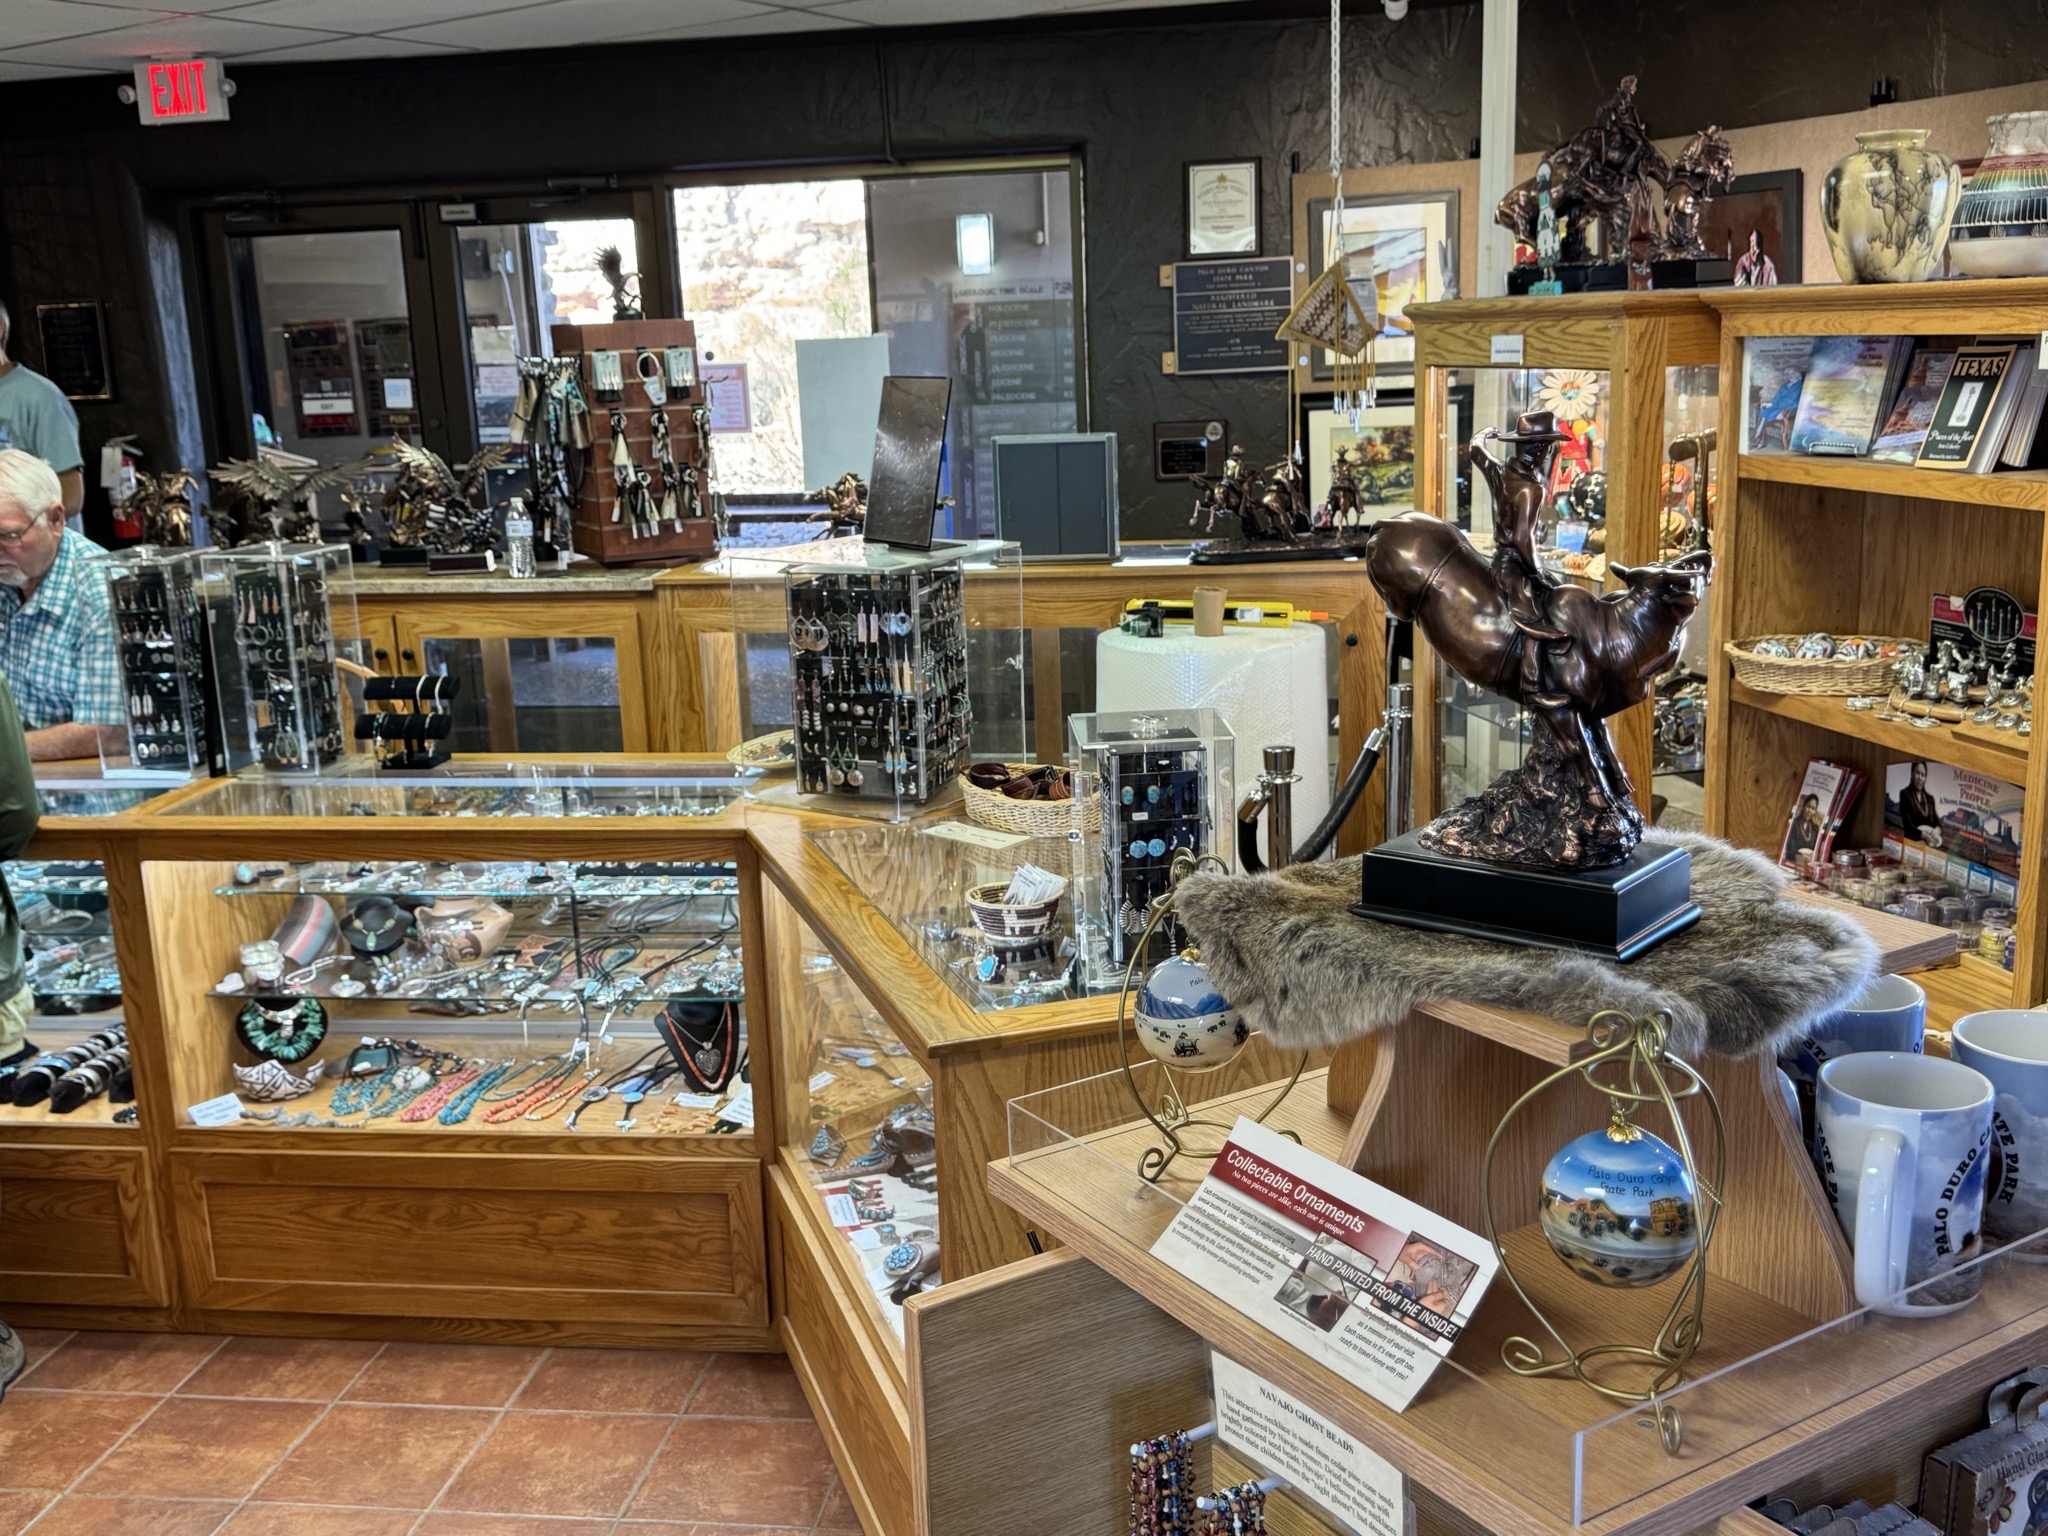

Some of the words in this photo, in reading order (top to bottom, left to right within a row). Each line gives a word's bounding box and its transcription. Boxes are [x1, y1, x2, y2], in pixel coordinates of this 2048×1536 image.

[148, 61, 208, 117] EXIT
[1955, 356, 2006, 376] TEXAS
[1227, 1149, 1292, 1192] Collectable
[1294, 1185, 1364, 1232] Ornaments
[1588, 1164, 1611, 1181] Palo
[1617, 1172, 1645, 1184] Duro
[1632, 1186, 1655, 1198] Park
[1940, 1147, 1978, 1202] DURO
[1998, 1152, 2020, 1204] PARK
[1232, 1169, 1241, 1178] No
[1240, 1175, 1252, 1184] two
[1249, 1181, 1268, 1193] pieces
[1267, 1191, 1278, 1199] are
[1277, 1195, 1291, 1208] alike,
[1292, 1204, 1307, 1215] each
[1306, 1212, 1318, 1221] one
[1318, 1216, 1324, 1224] is
[1324, 1221, 1344, 1235] unique
[1934, 1207, 1950, 1258] PALO
[1305, 1245, 1333, 1266] HAND
[1331, 1260, 1372, 1288] PAINTED
[1370, 1282, 1401, 1304] FROM
[1399, 1298, 1421, 1316] THE
[1418, 1306, 1458, 1338] INSIDE!
[1221, 1387, 1234, 1402] This
[1264, 1415, 1290, 1435] necklace
[1259, 1386, 1293, 1413] NAVAJO
[1294, 1409, 1324, 1433] GHOST
[1326, 1429, 1353, 1454] BEADS
[1268, 1426, 1276, 1439] by
[1260, 1446, 1284, 1465] children
